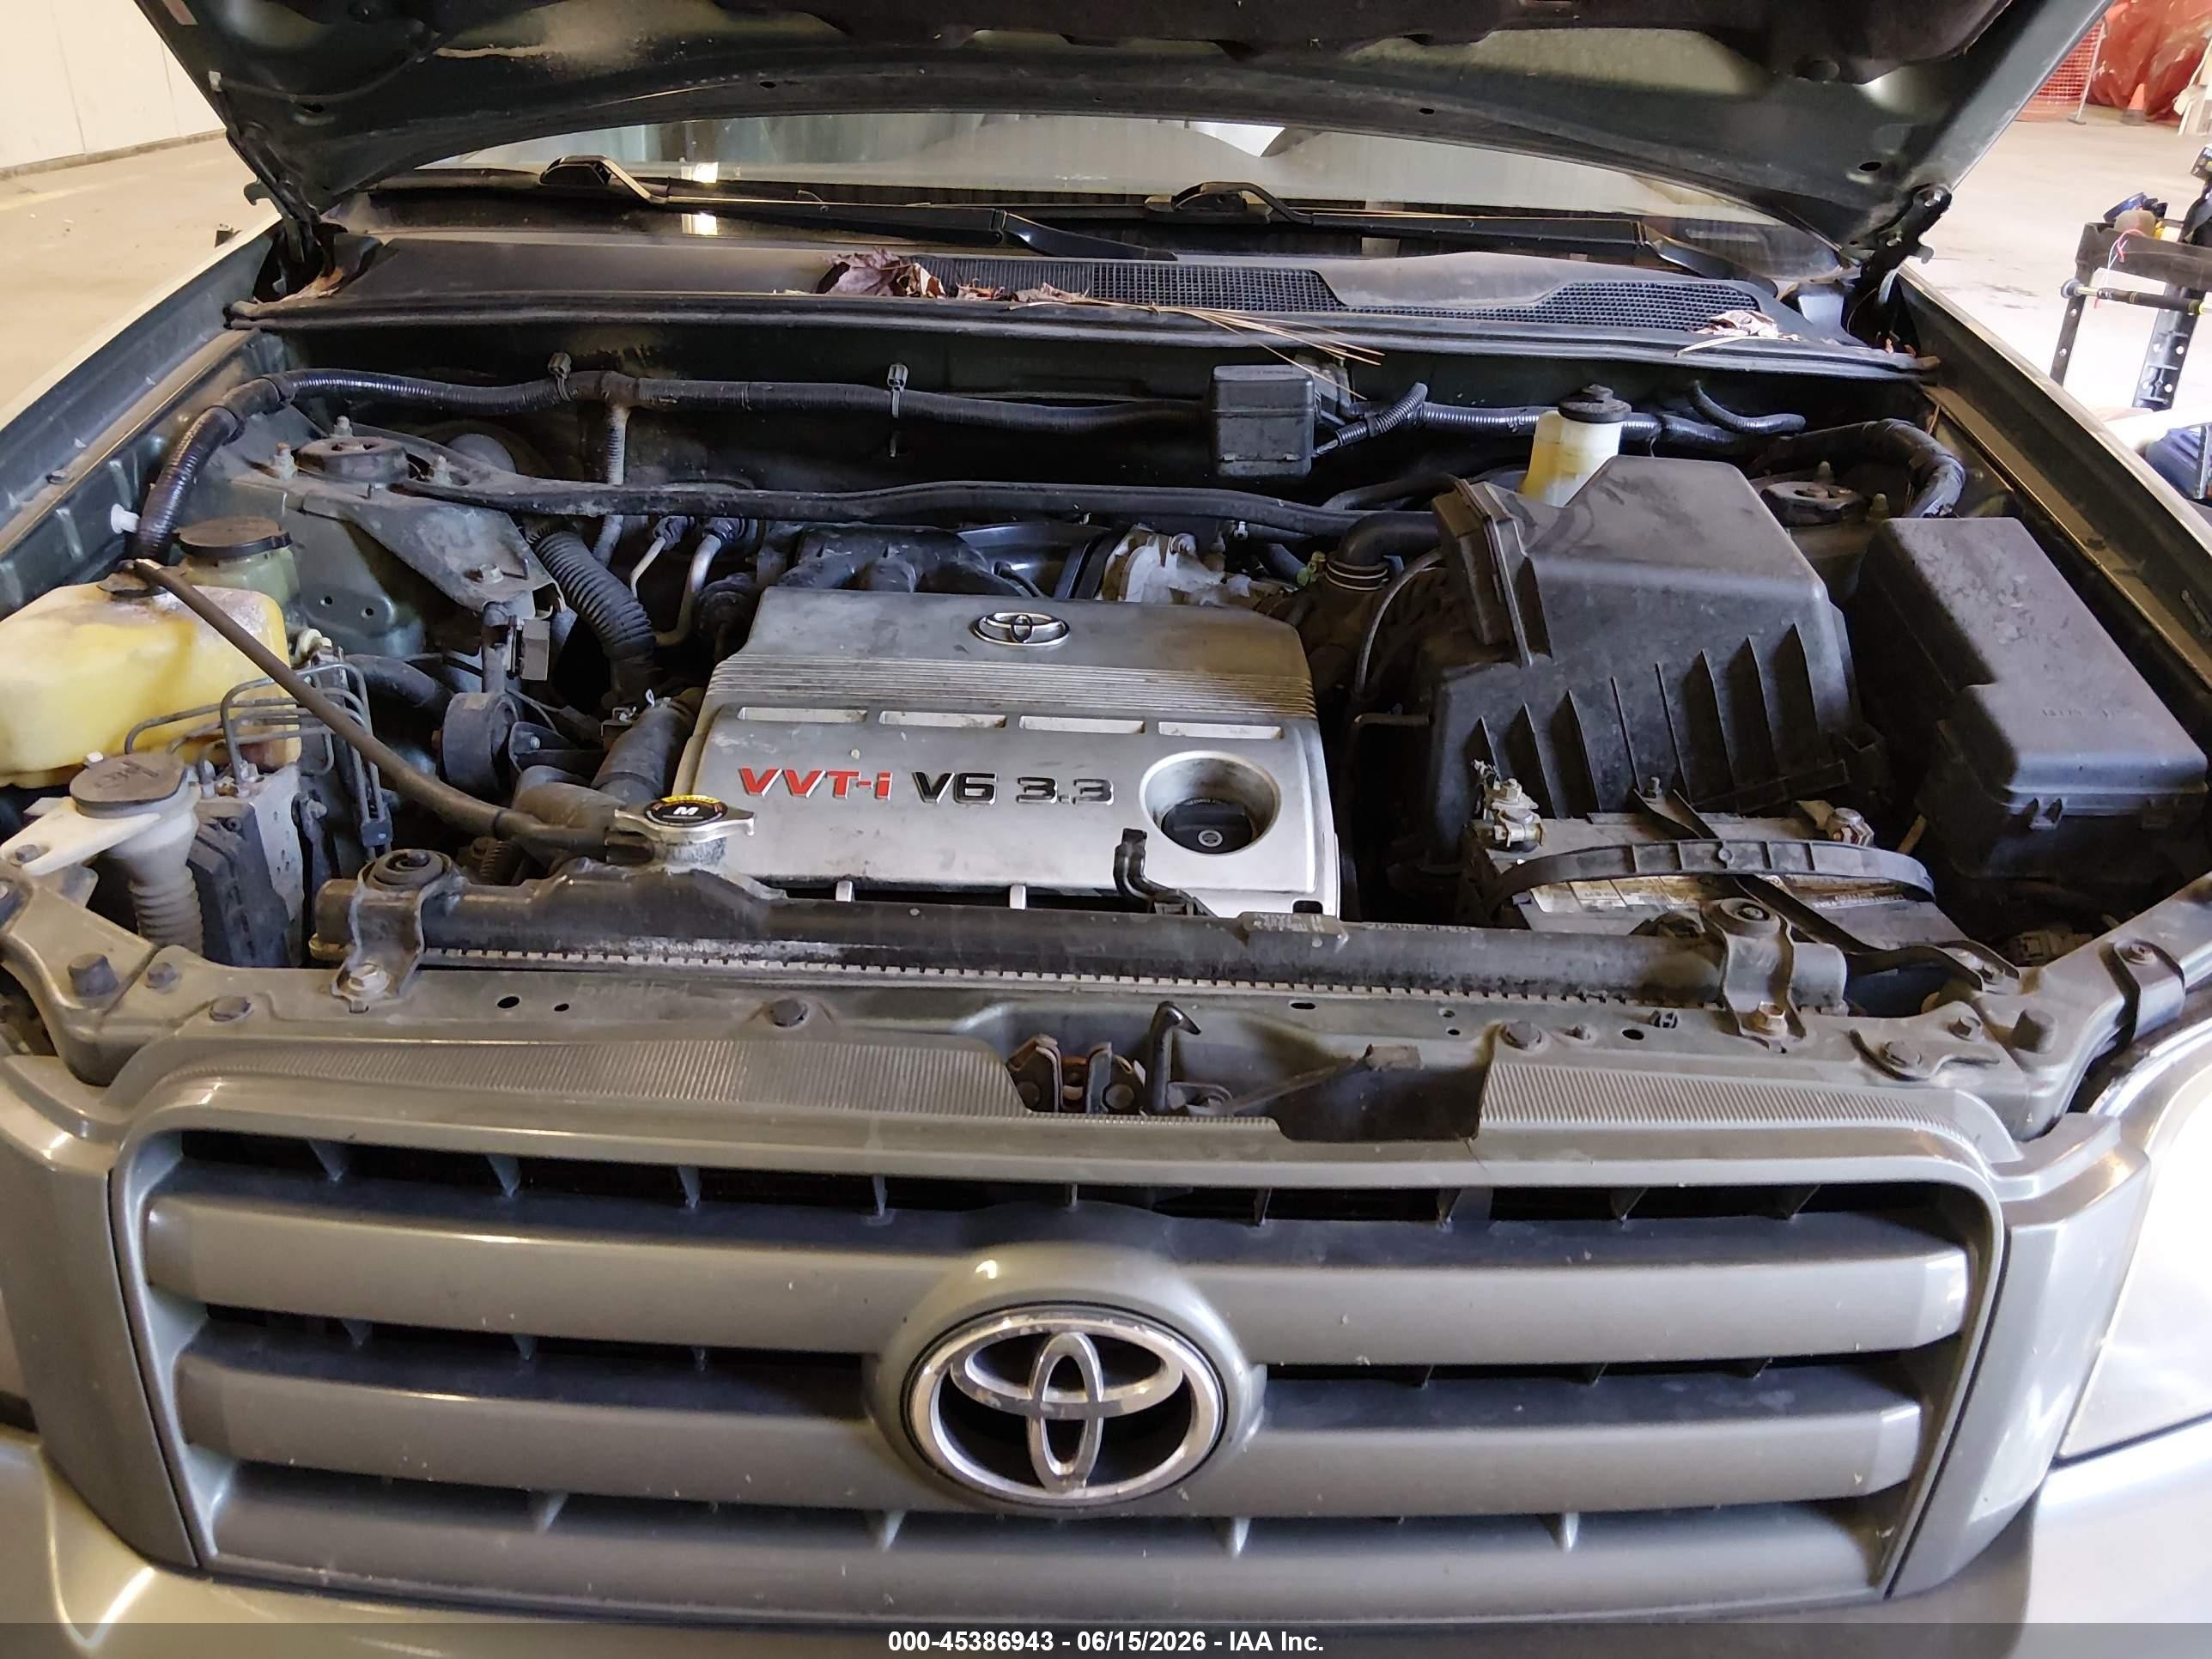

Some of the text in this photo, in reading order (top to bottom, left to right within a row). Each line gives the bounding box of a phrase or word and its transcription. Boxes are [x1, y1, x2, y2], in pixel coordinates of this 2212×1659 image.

[738, 766, 1115, 805] VVT-i V6 3.3
